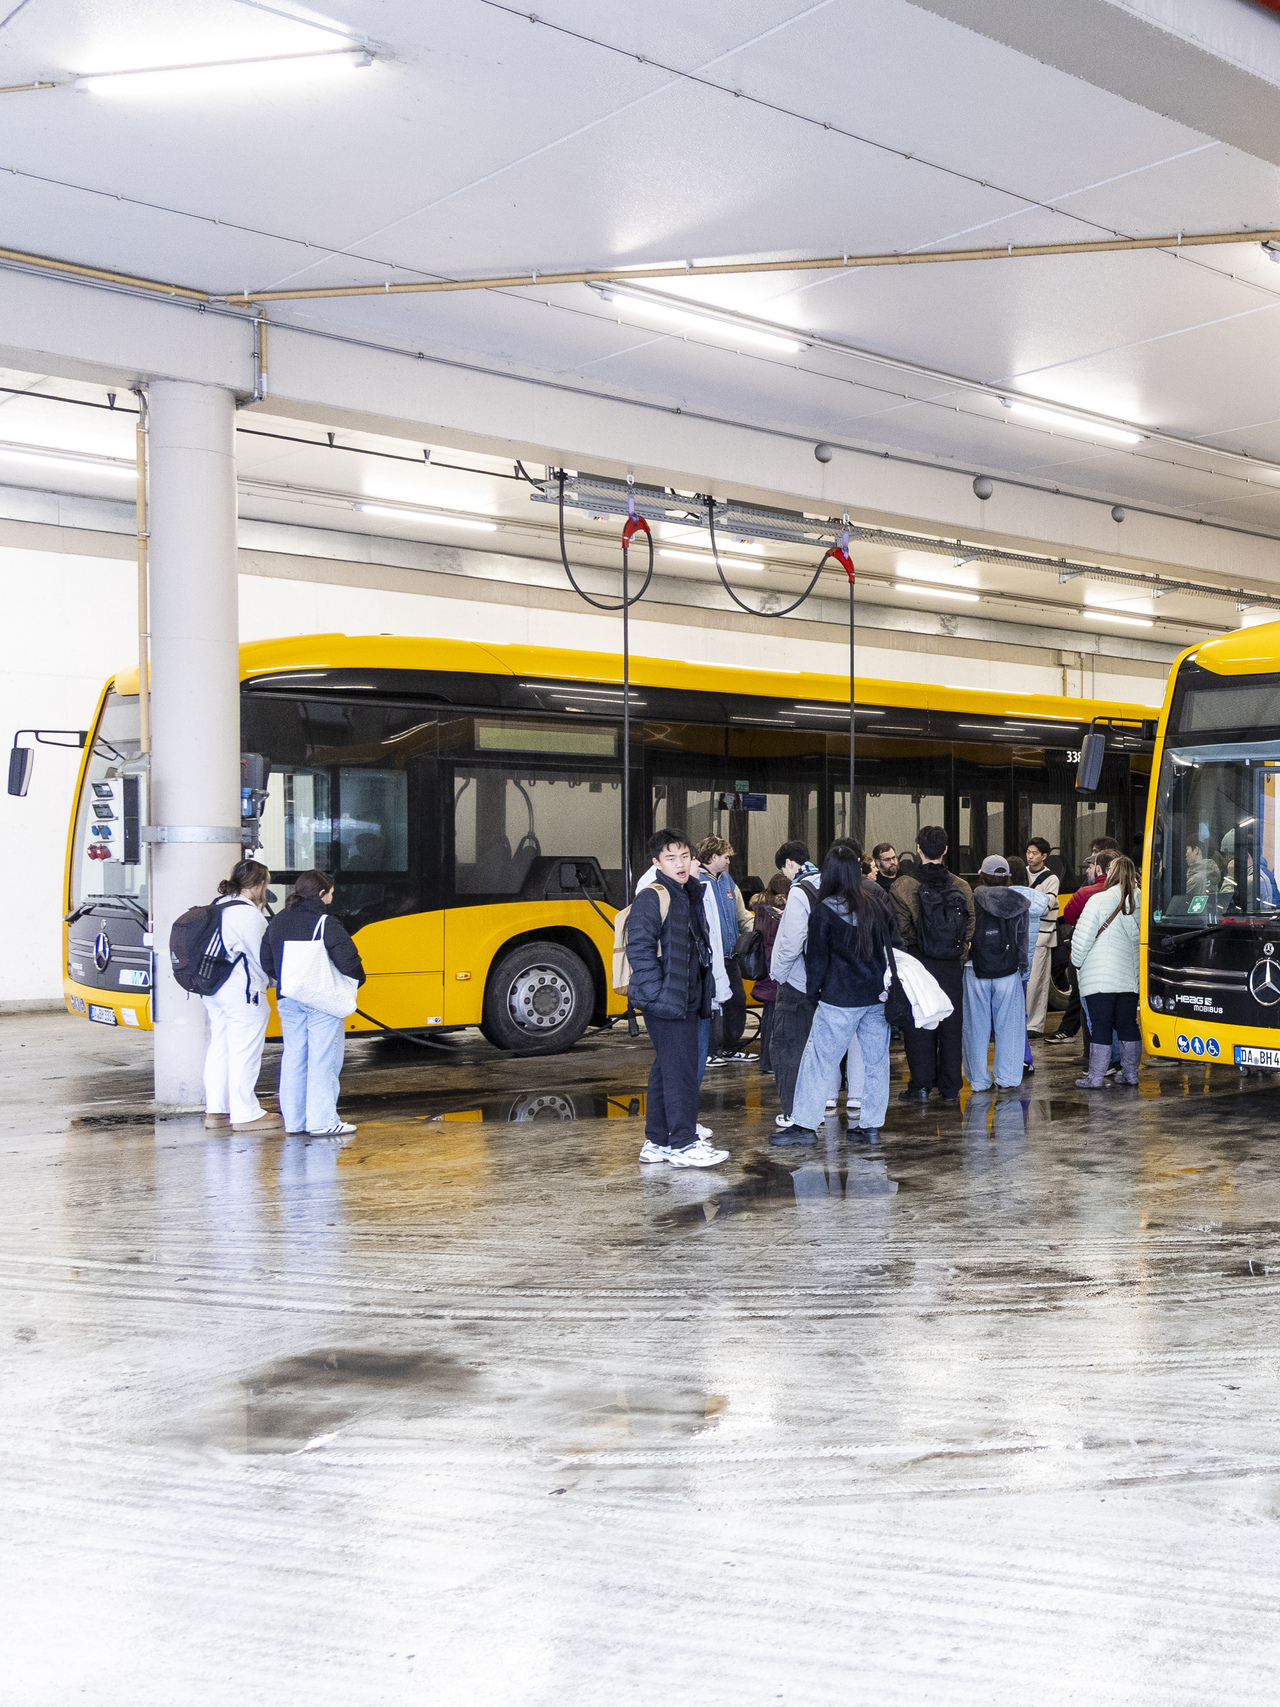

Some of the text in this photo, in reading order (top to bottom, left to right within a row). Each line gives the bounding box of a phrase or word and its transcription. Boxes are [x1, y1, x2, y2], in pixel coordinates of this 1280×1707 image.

[1193, 1004, 1224, 1014] MOBIBUS
[1241, 1049, 1253, 1063] DA
[1259, 1051, 1272, 1065] BH
